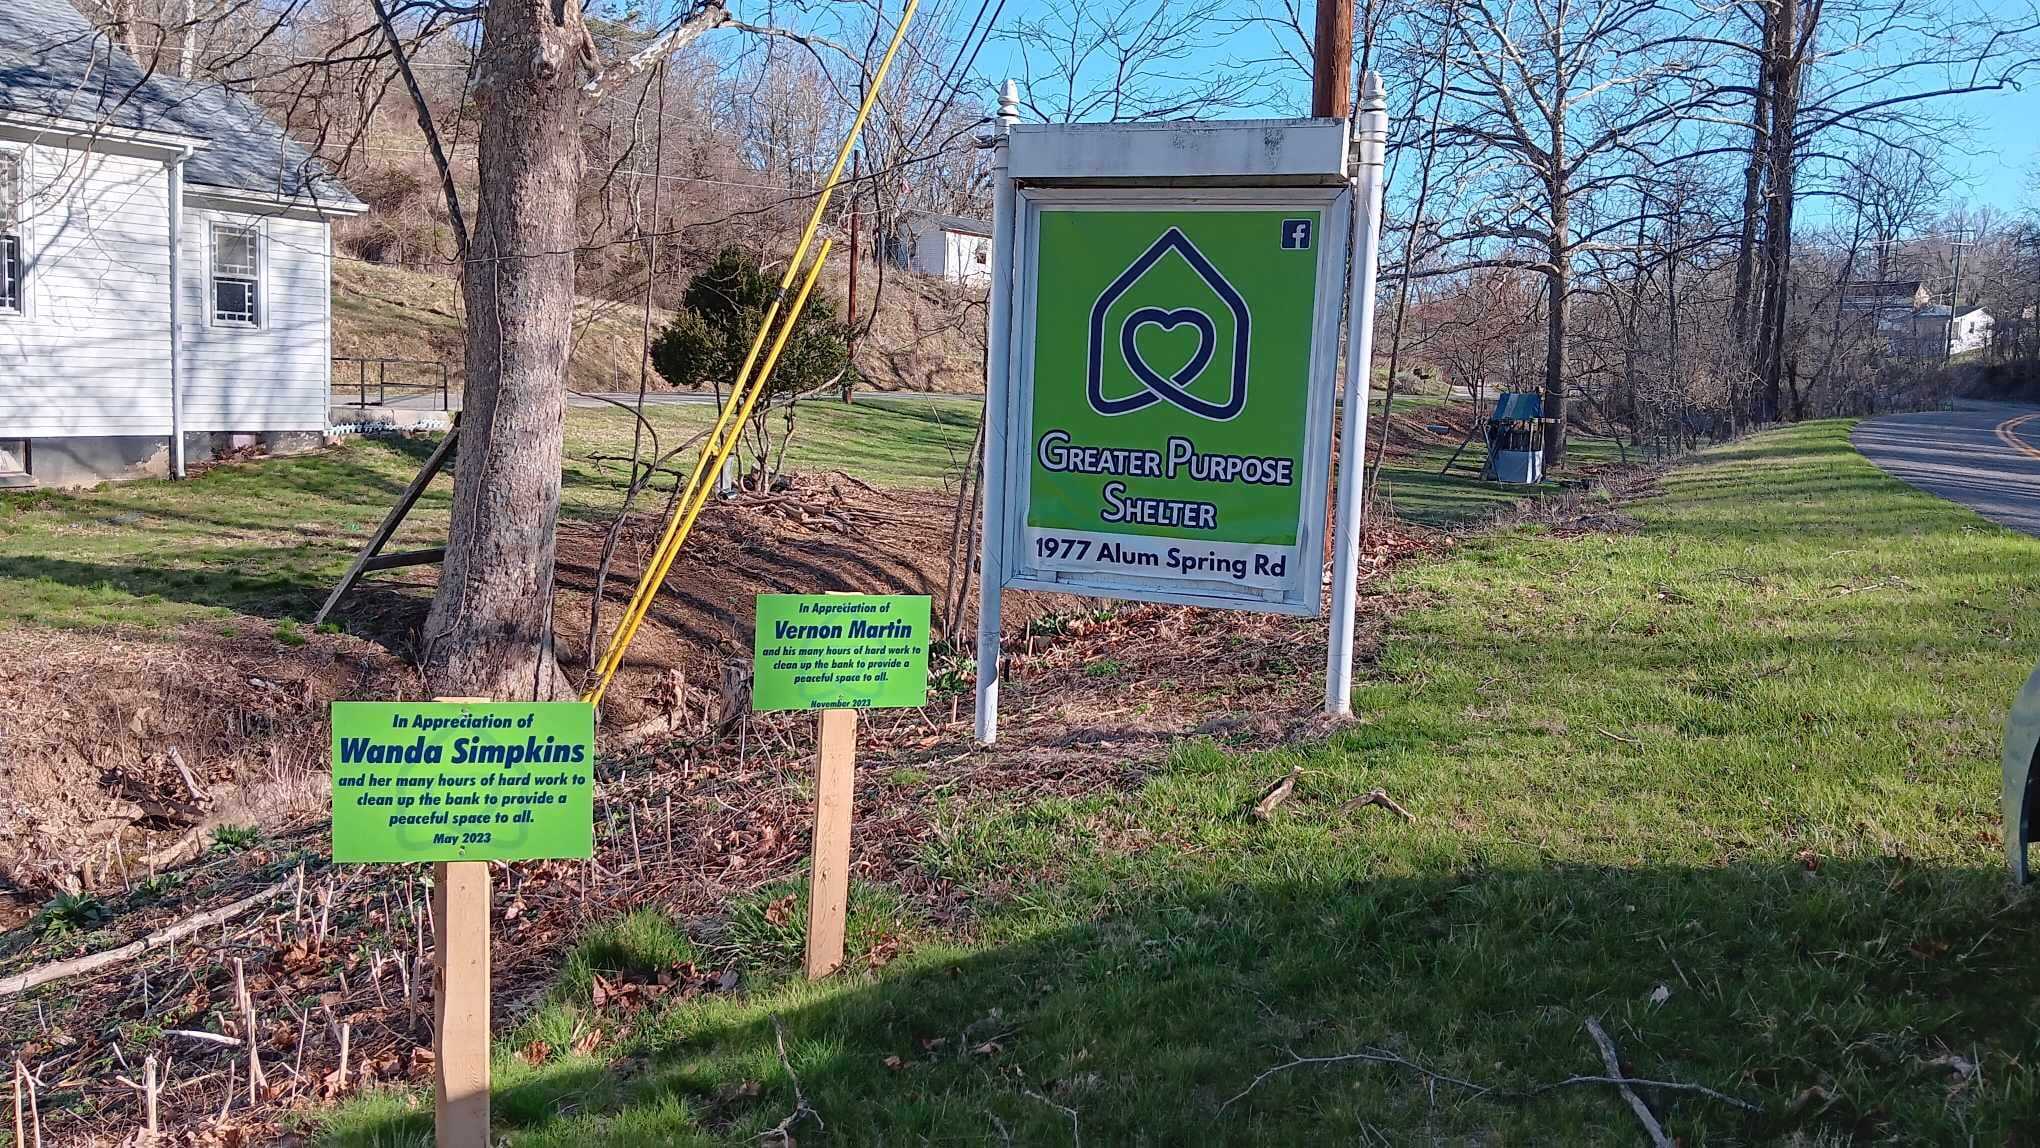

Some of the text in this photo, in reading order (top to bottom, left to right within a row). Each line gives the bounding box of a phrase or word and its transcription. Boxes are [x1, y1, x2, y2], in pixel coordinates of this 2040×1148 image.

[1036, 537, 1286, 579] 1977 Alum Spring Rd
[799, 602, 891, 615] In Appreciation of
[775, 619, 912, 639] Vernon Martin
[763, 646, 920, 657] and his many hours of hard work to
[773, 661, 797, 669] clean
[800, 662, 812, 671] up
[815, 660, 828, 669] the
[831, 660, 854, 668] bank
[868, 659, 901, 669] provide
[794, 673, 833, 684] peaceful
[835, 674, 860, 684] space
[874, 672, 888, 681] all.
[811, 699, 871, 708] November 2023
[392, 713, 534, 731] In Appreciation of
[340, 735, 585, 768] Wanda Simpkins
[339, 773, 585, 788] and her many hours of hard work to
[357, 792, 567, 808] clean up the bank to provide a
[389, 810, 534, 826] peaceful space to all.
[433, 832, 491, 845] May 2023
